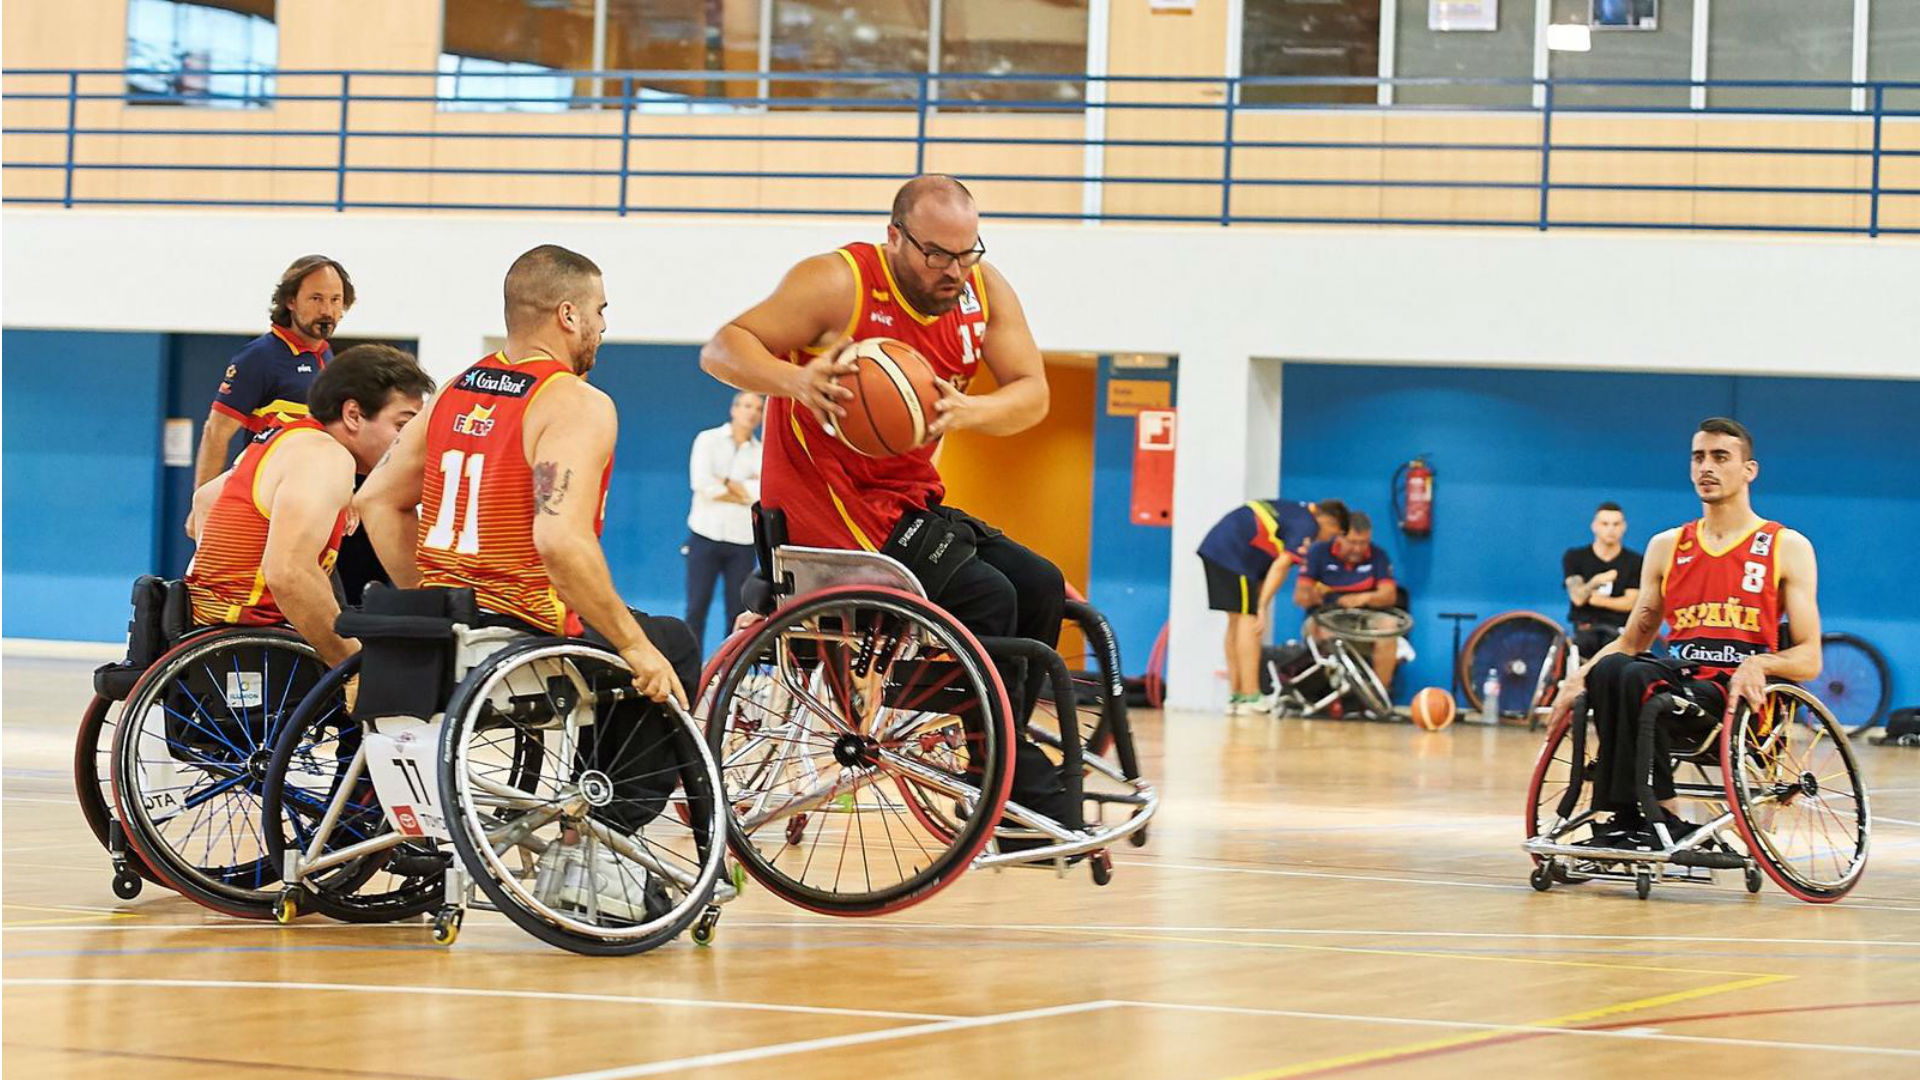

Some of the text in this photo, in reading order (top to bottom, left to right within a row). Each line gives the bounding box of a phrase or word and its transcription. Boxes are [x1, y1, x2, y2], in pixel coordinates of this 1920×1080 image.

[423, 449, 485, 555] 11
[1741, 560, 1767, 593] 8
[391, 758, 432, 806] 11
